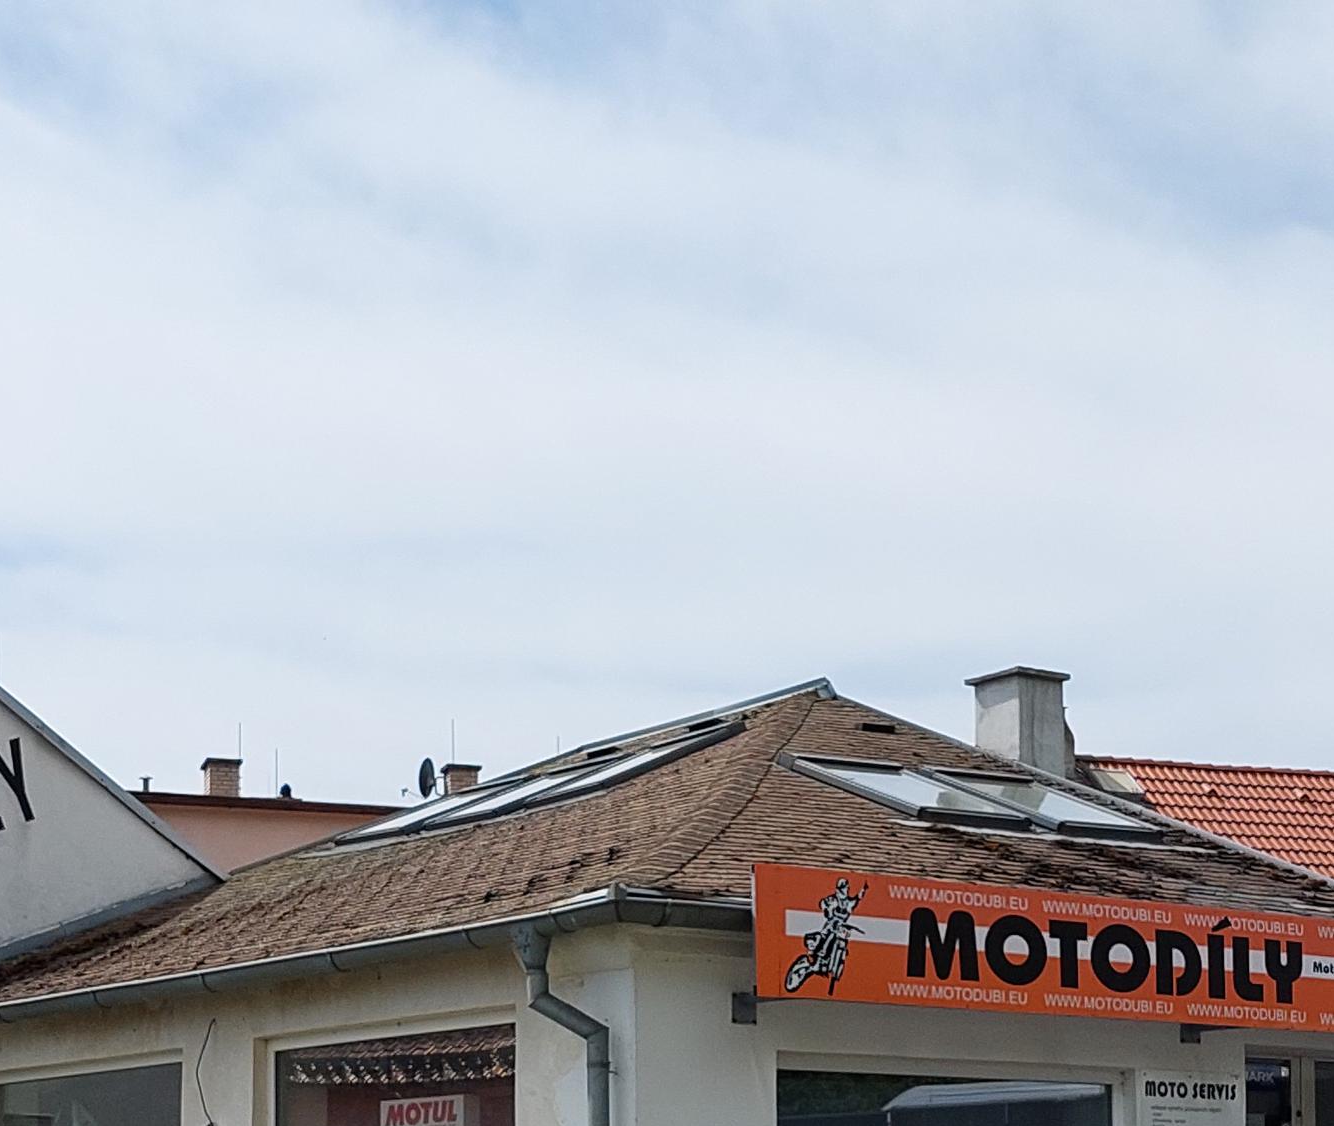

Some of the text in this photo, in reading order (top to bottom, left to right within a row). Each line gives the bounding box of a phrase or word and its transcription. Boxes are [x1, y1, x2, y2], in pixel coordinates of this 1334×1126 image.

[888, 885, 1029, 911] WWW.MOTODUBI.EU
[1042, 900, 1172, 924] WWW.MOTODUBI.EU
[906, 906, 1303, 1005] MOTODÍLY
[888, 983, 1028, 1005] WWW.MOTODUBI.EU
[1044, 993, 1174, 1015] WWW.MOTODUBI.EU
[1187, 1003, 1307, 1024] WWW.MOTODUBI.EU
[1145, 1080, 1236, 1100] MOTO SERVIS
[385, 1100, 458, 1126] MOTUL
